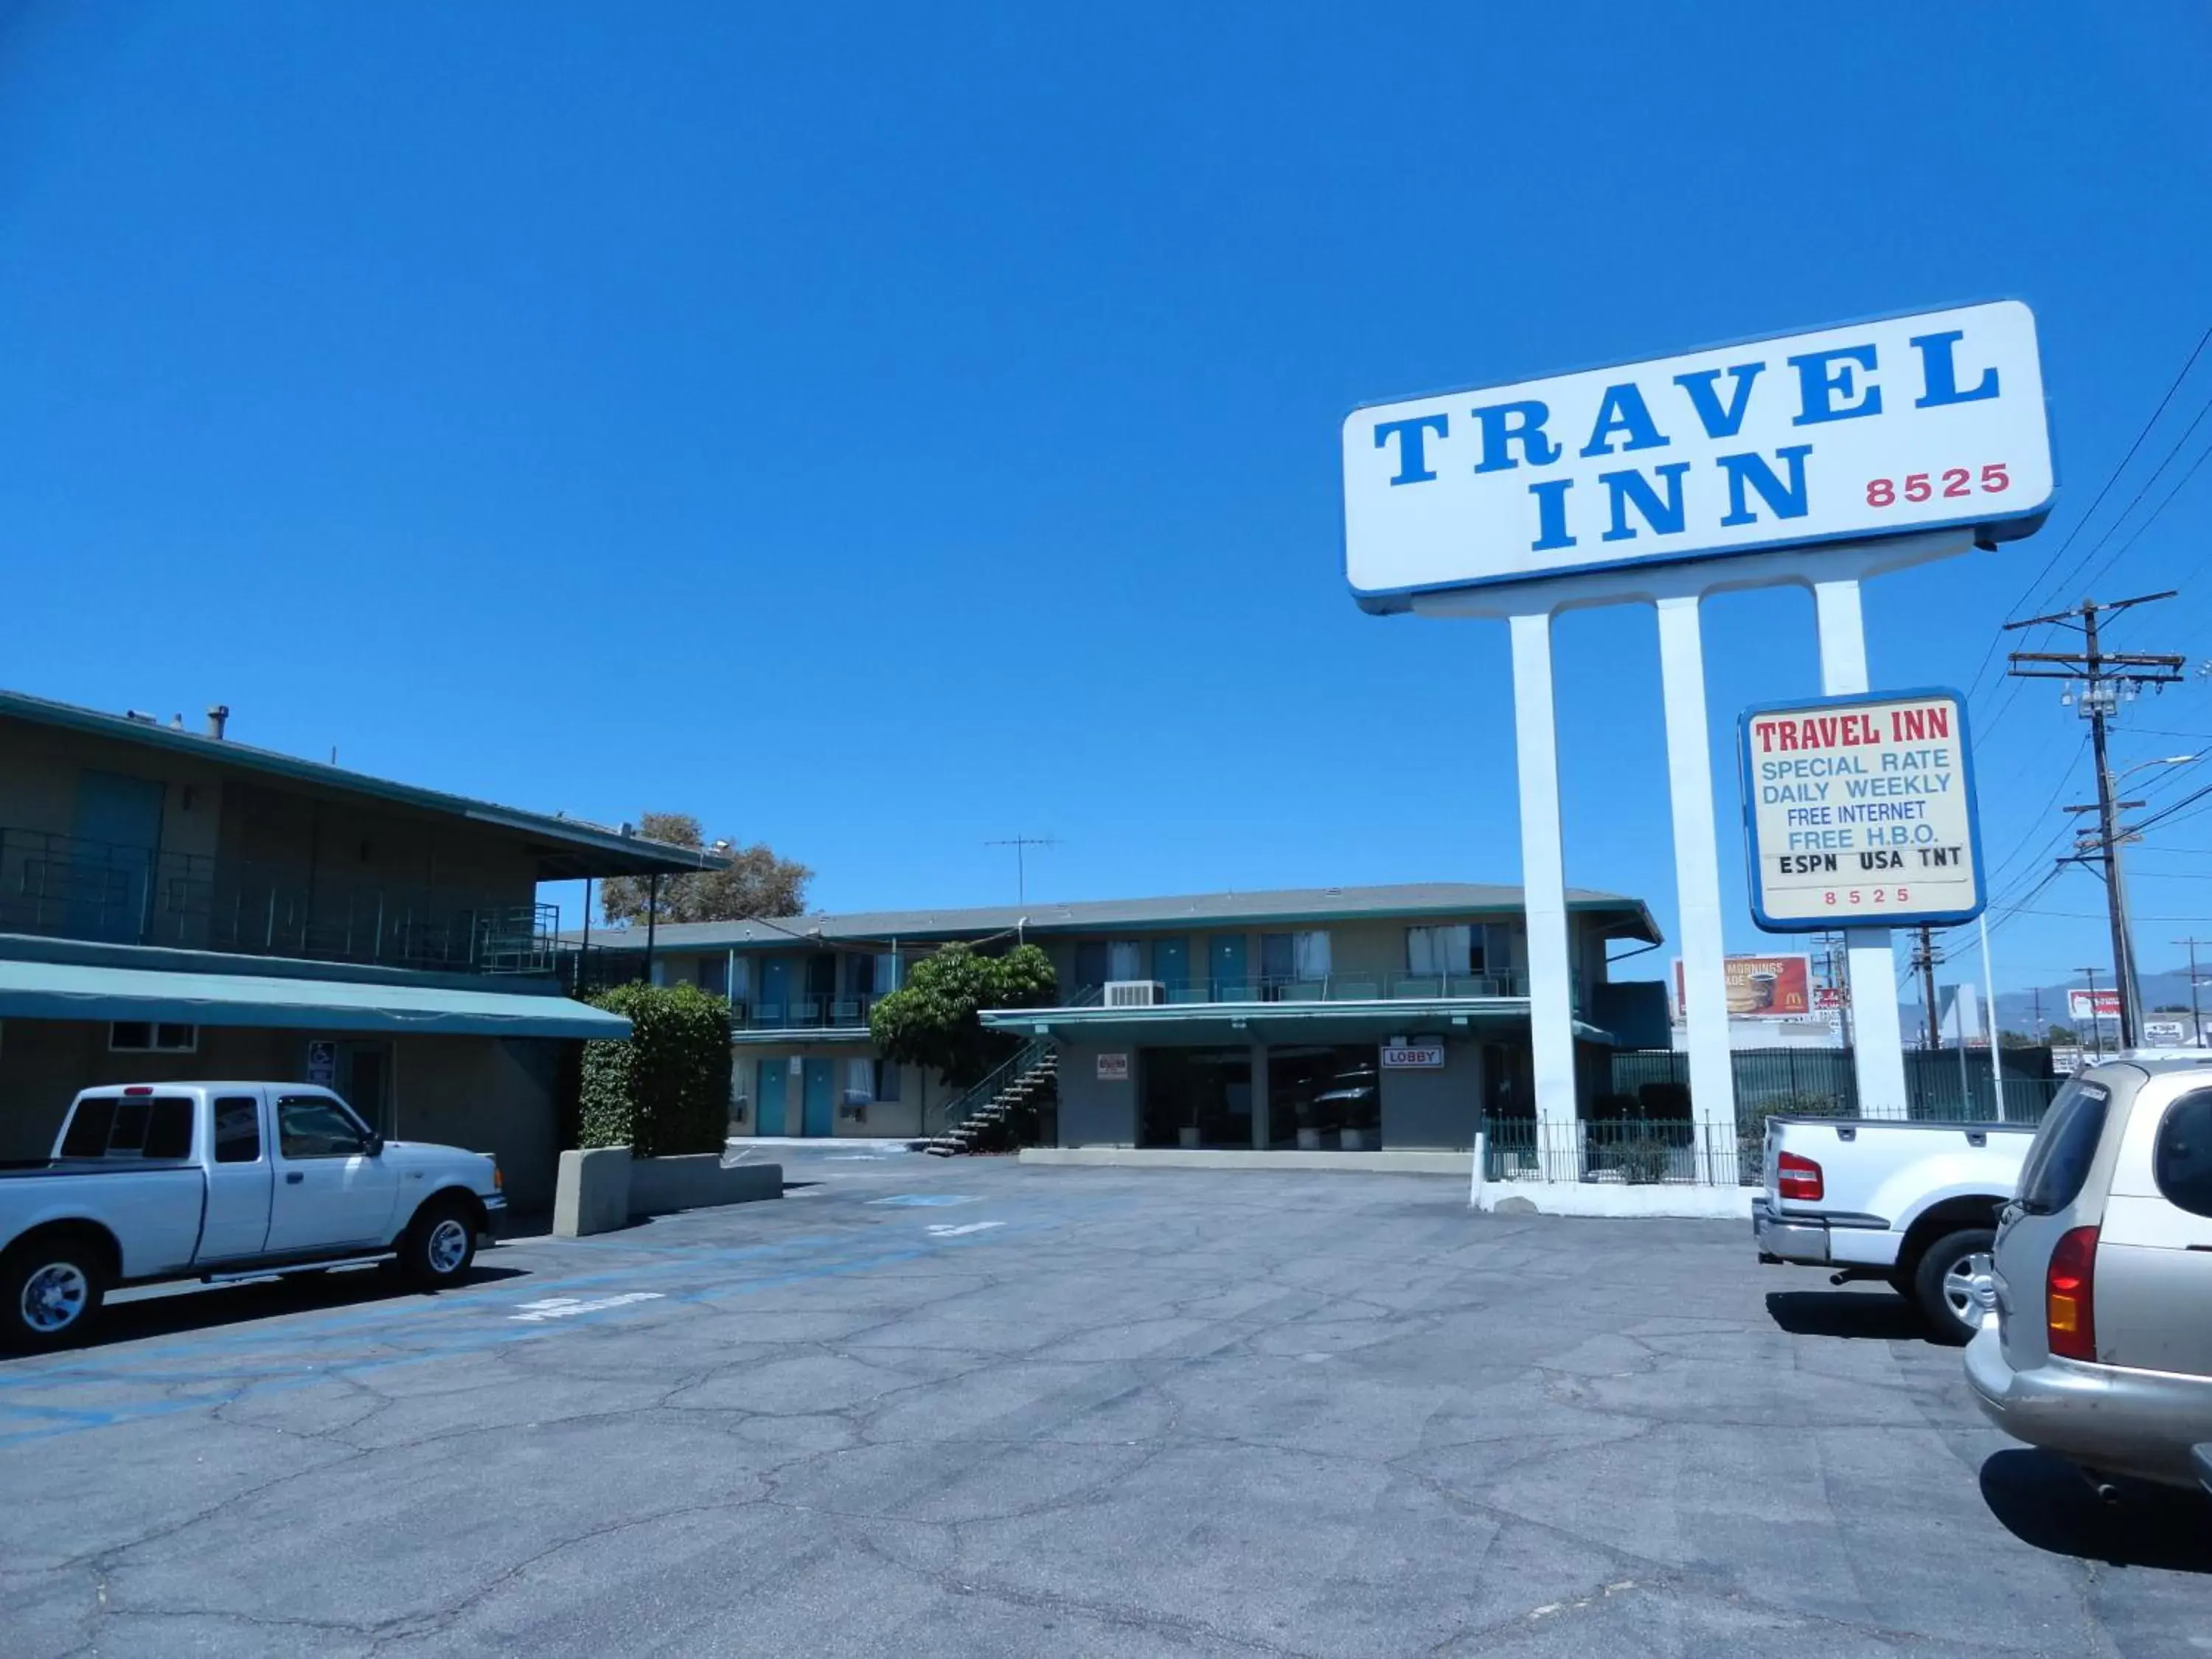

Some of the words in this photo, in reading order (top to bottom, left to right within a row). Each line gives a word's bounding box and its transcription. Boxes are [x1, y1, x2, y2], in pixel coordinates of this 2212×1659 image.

[1374, 330, 2001, 487] TRAVEL
[1528, 444, 1814, 552] INN
[1865, 462, 2011, 509] 8525
[1756, 714, 1880, 753] TRAVEL
[1891, 707, 1949, 742] INN
[1761, 756, 1868, 782] SPECIAL
[1881, 748, 1950, 773] RATE
[1763, 782, 1829, 804] DAILY
[1845, 773, 1951, 799] WEEKLY
[1787, 807, 1832, 827] FREE
[1838, 801, 1926, 823] INTERNET
[1789, 829, 1854, 850] FREE
[1867, 824, 1938, 847] H.B.O.
[1779, 854, 1838, 874] ESPN
[1860, 850, 1904, 871] USA
[1918, 846, 1962, 867] TNT
[1725, 975, 1746, 986] ADE
[1727, 962, 1784, 974] MORNINGS
[1390, 1051, 1435, 1062] LOBBY
